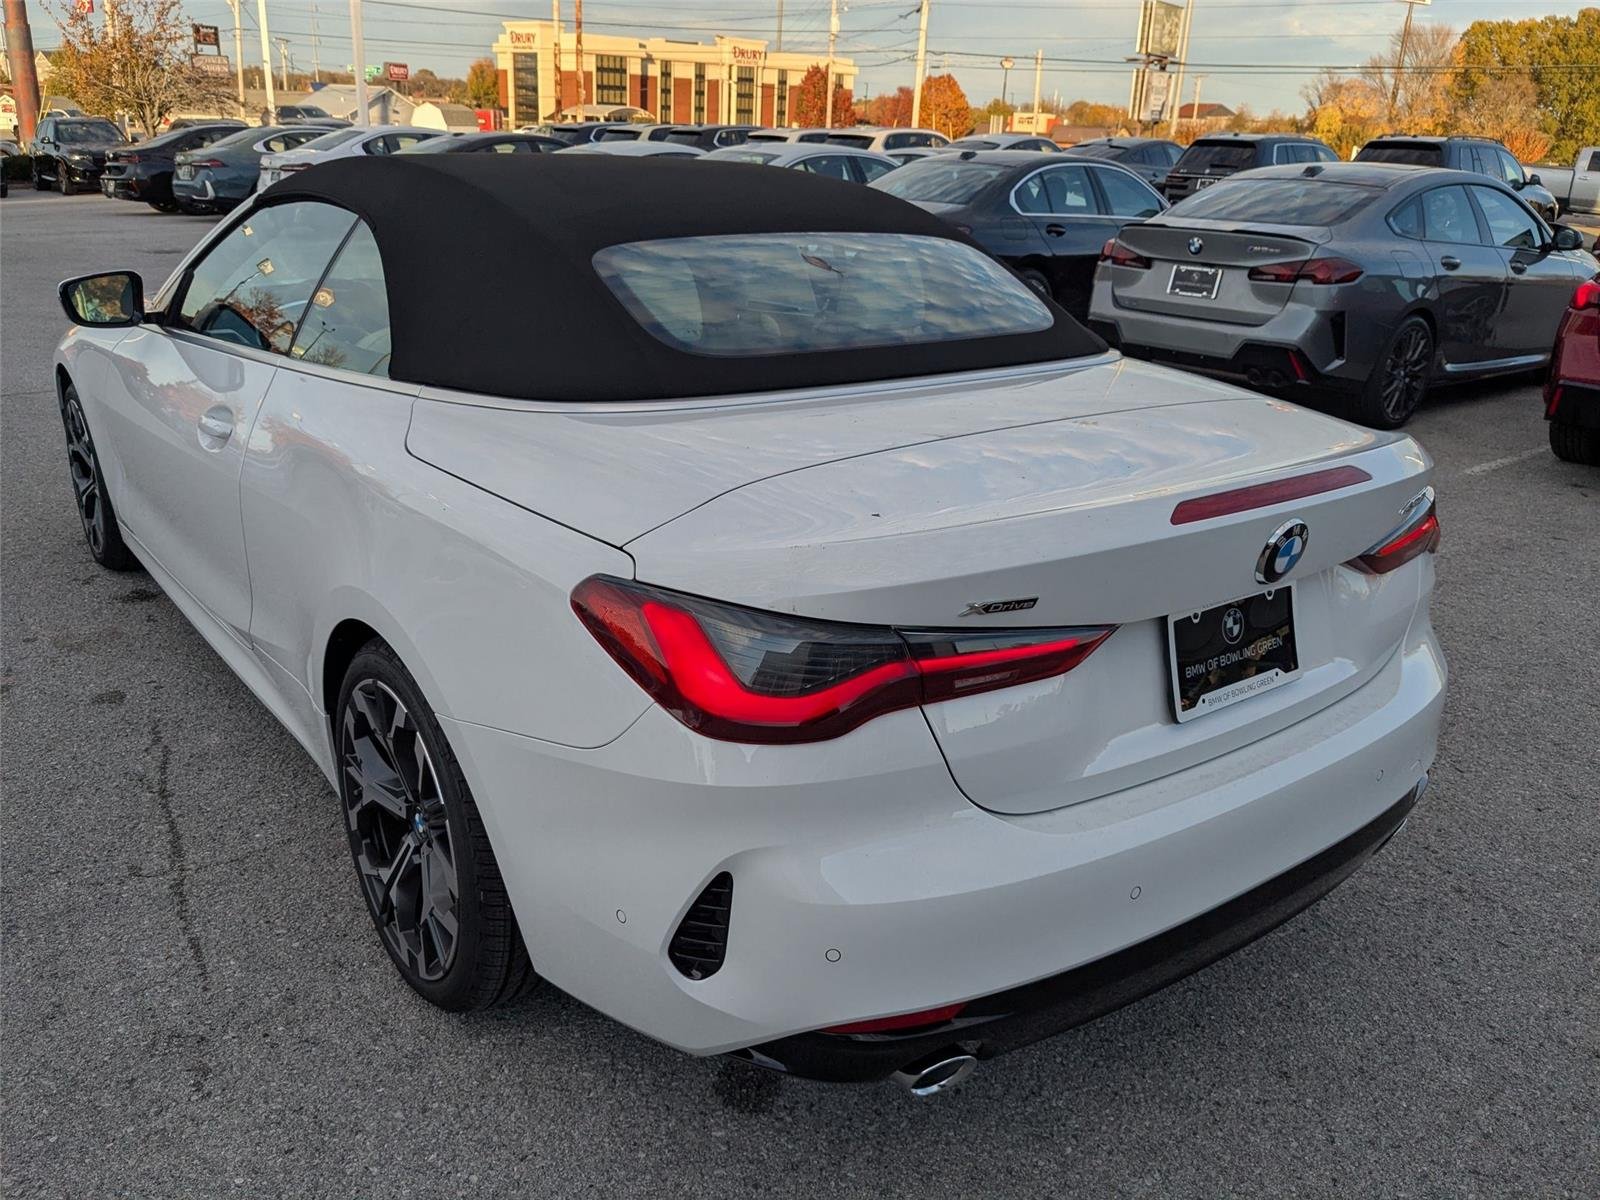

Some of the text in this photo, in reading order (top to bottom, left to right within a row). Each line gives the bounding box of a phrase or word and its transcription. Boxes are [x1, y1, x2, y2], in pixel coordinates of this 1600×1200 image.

[1185, 637, 1283, 679] BMW OF BOWLING GREEN
[1207, 675, 1275, 707] BMW OF BOWLING GREEN
